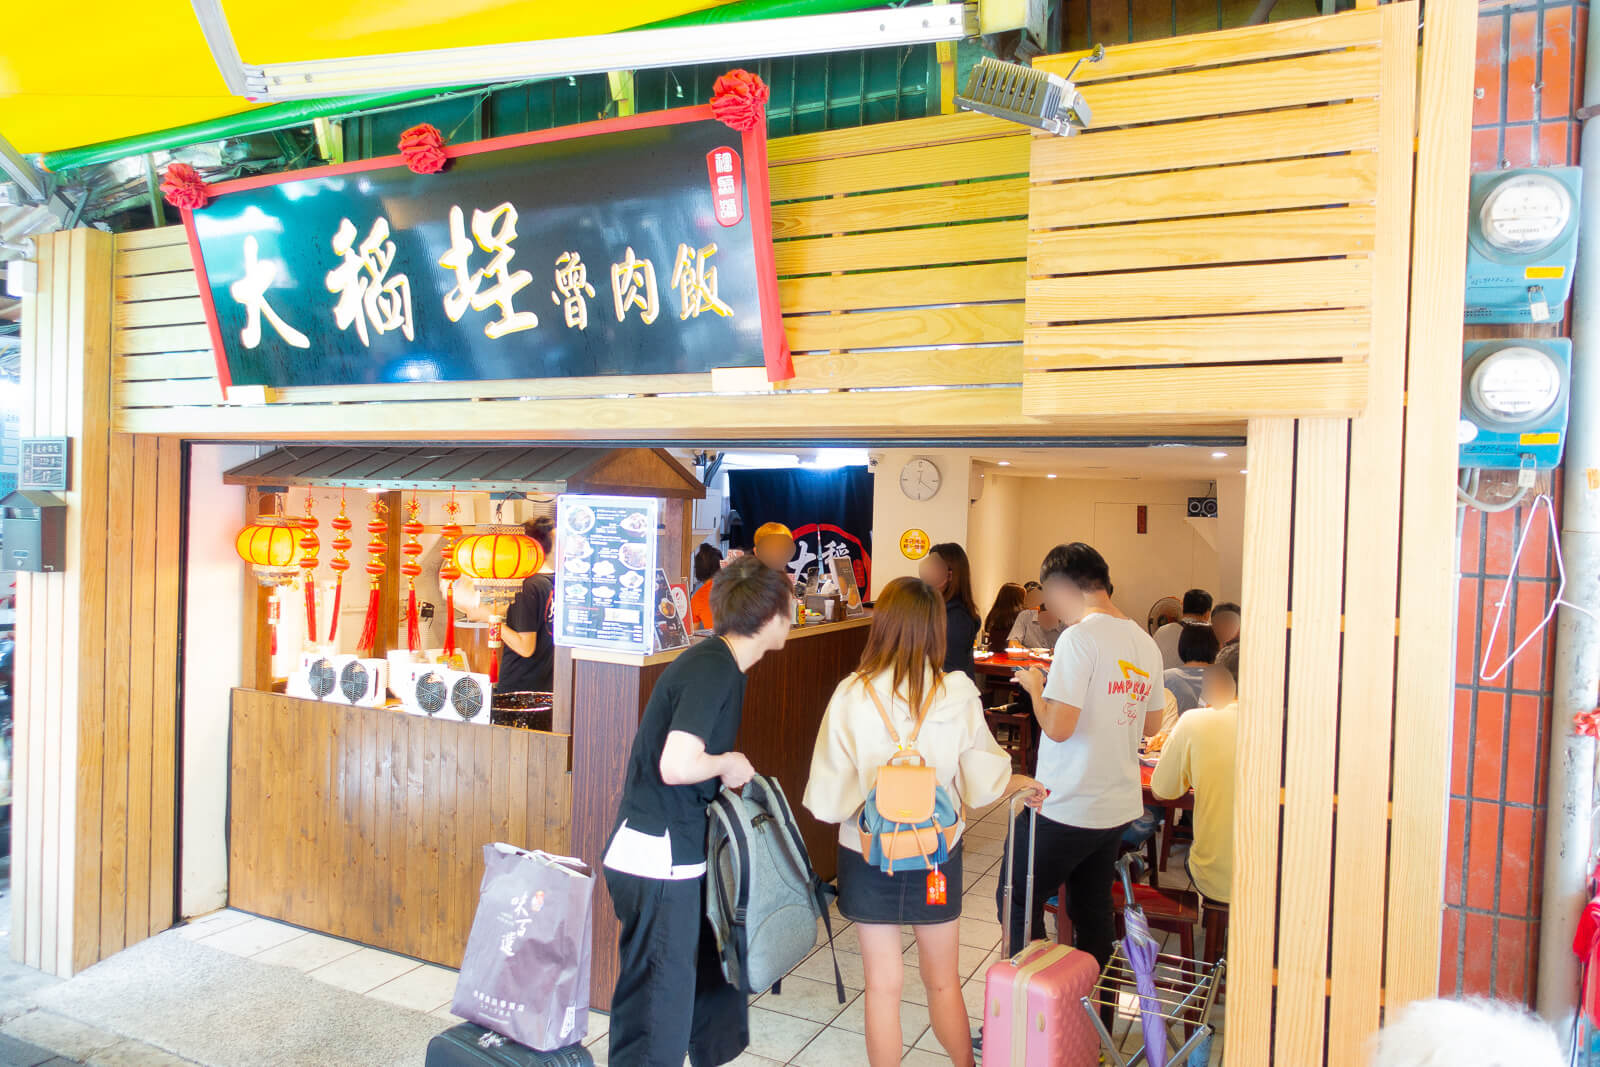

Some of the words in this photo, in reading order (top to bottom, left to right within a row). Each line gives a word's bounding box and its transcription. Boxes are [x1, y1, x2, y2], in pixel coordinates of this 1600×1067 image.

[231, 201, 734, 350] 大稻埕魯肉飯
